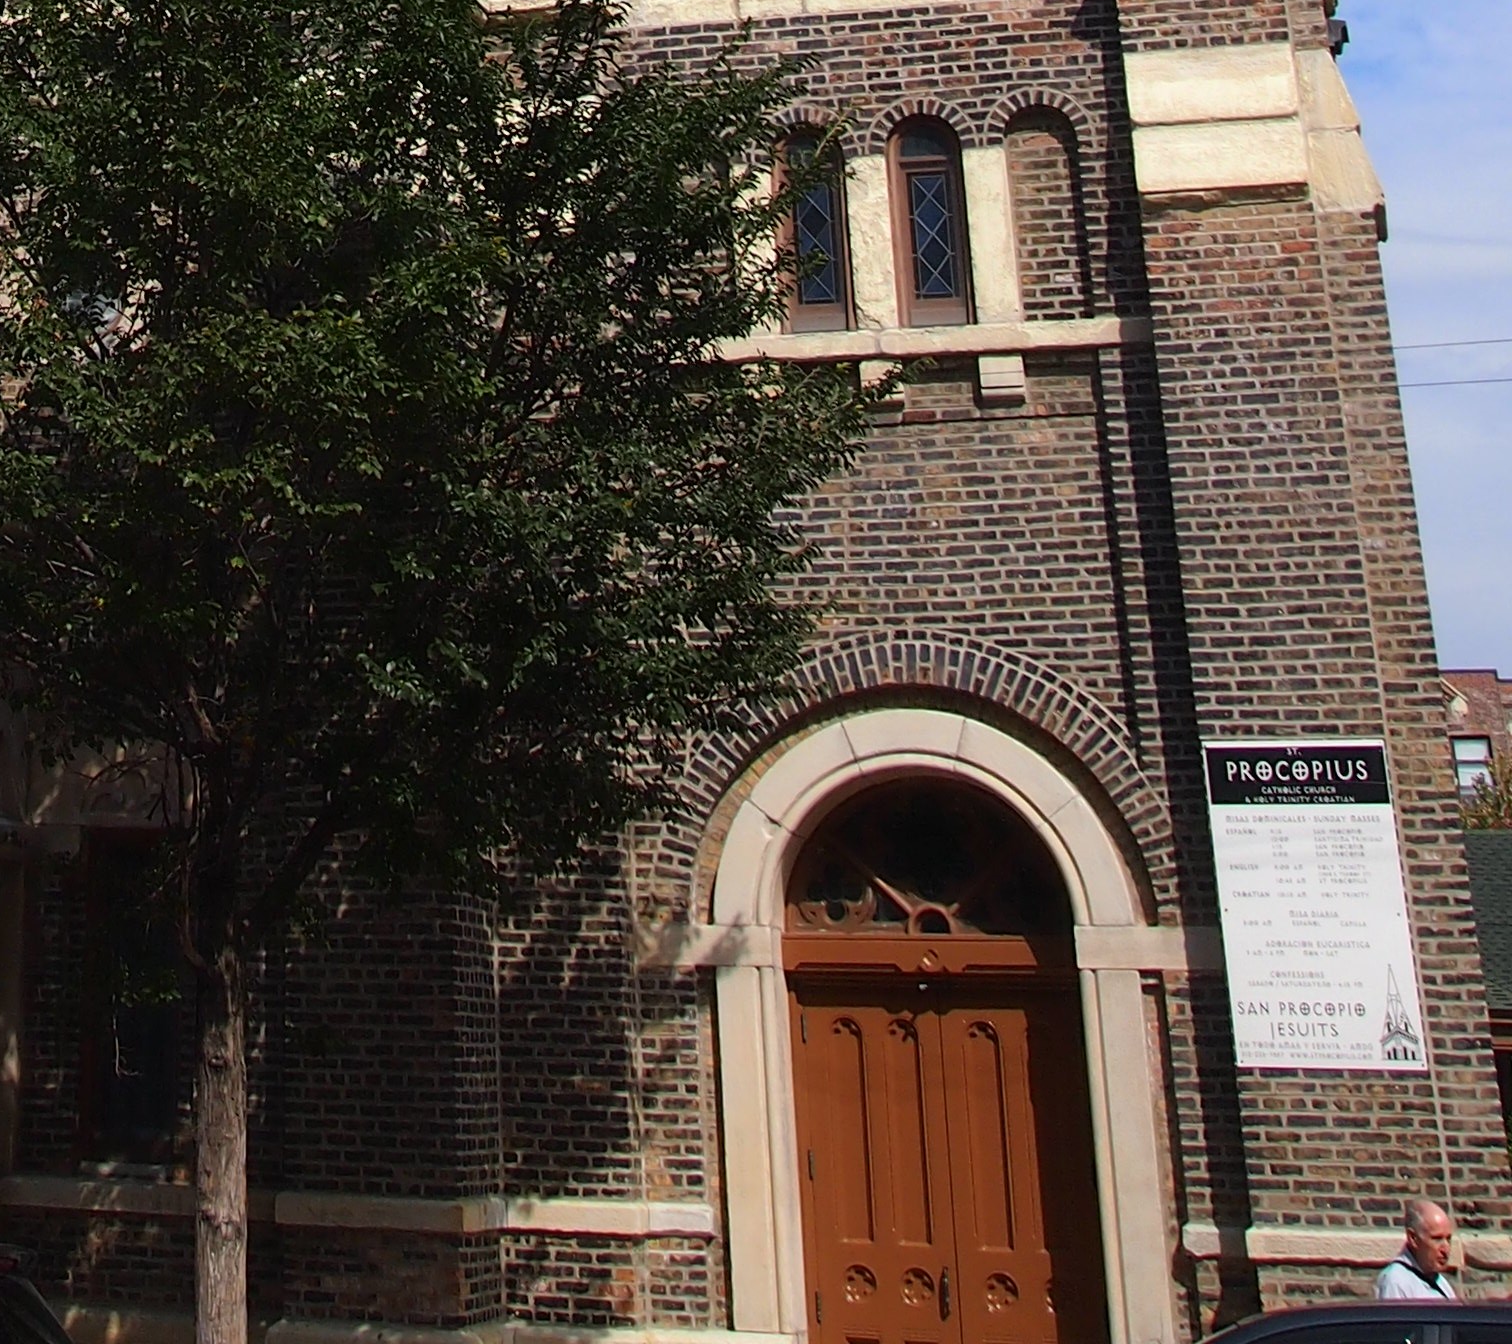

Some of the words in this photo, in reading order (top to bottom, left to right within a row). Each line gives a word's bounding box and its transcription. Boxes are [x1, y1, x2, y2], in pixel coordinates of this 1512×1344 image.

[1226, 760, 1368, 781] PROCOPIUS
[1260, 785, 1300, 795] CATHOLIC
[1303, 785, 1337, 794] CHURCH
[1313, 815, 1345, 823] SUNDAY
[1237, 1001, 1270, 1016] SAN
[1279, 1001, 1366, 1017] PROCOPIO
[1271, 1022, 1339, 1040] JESUITS
